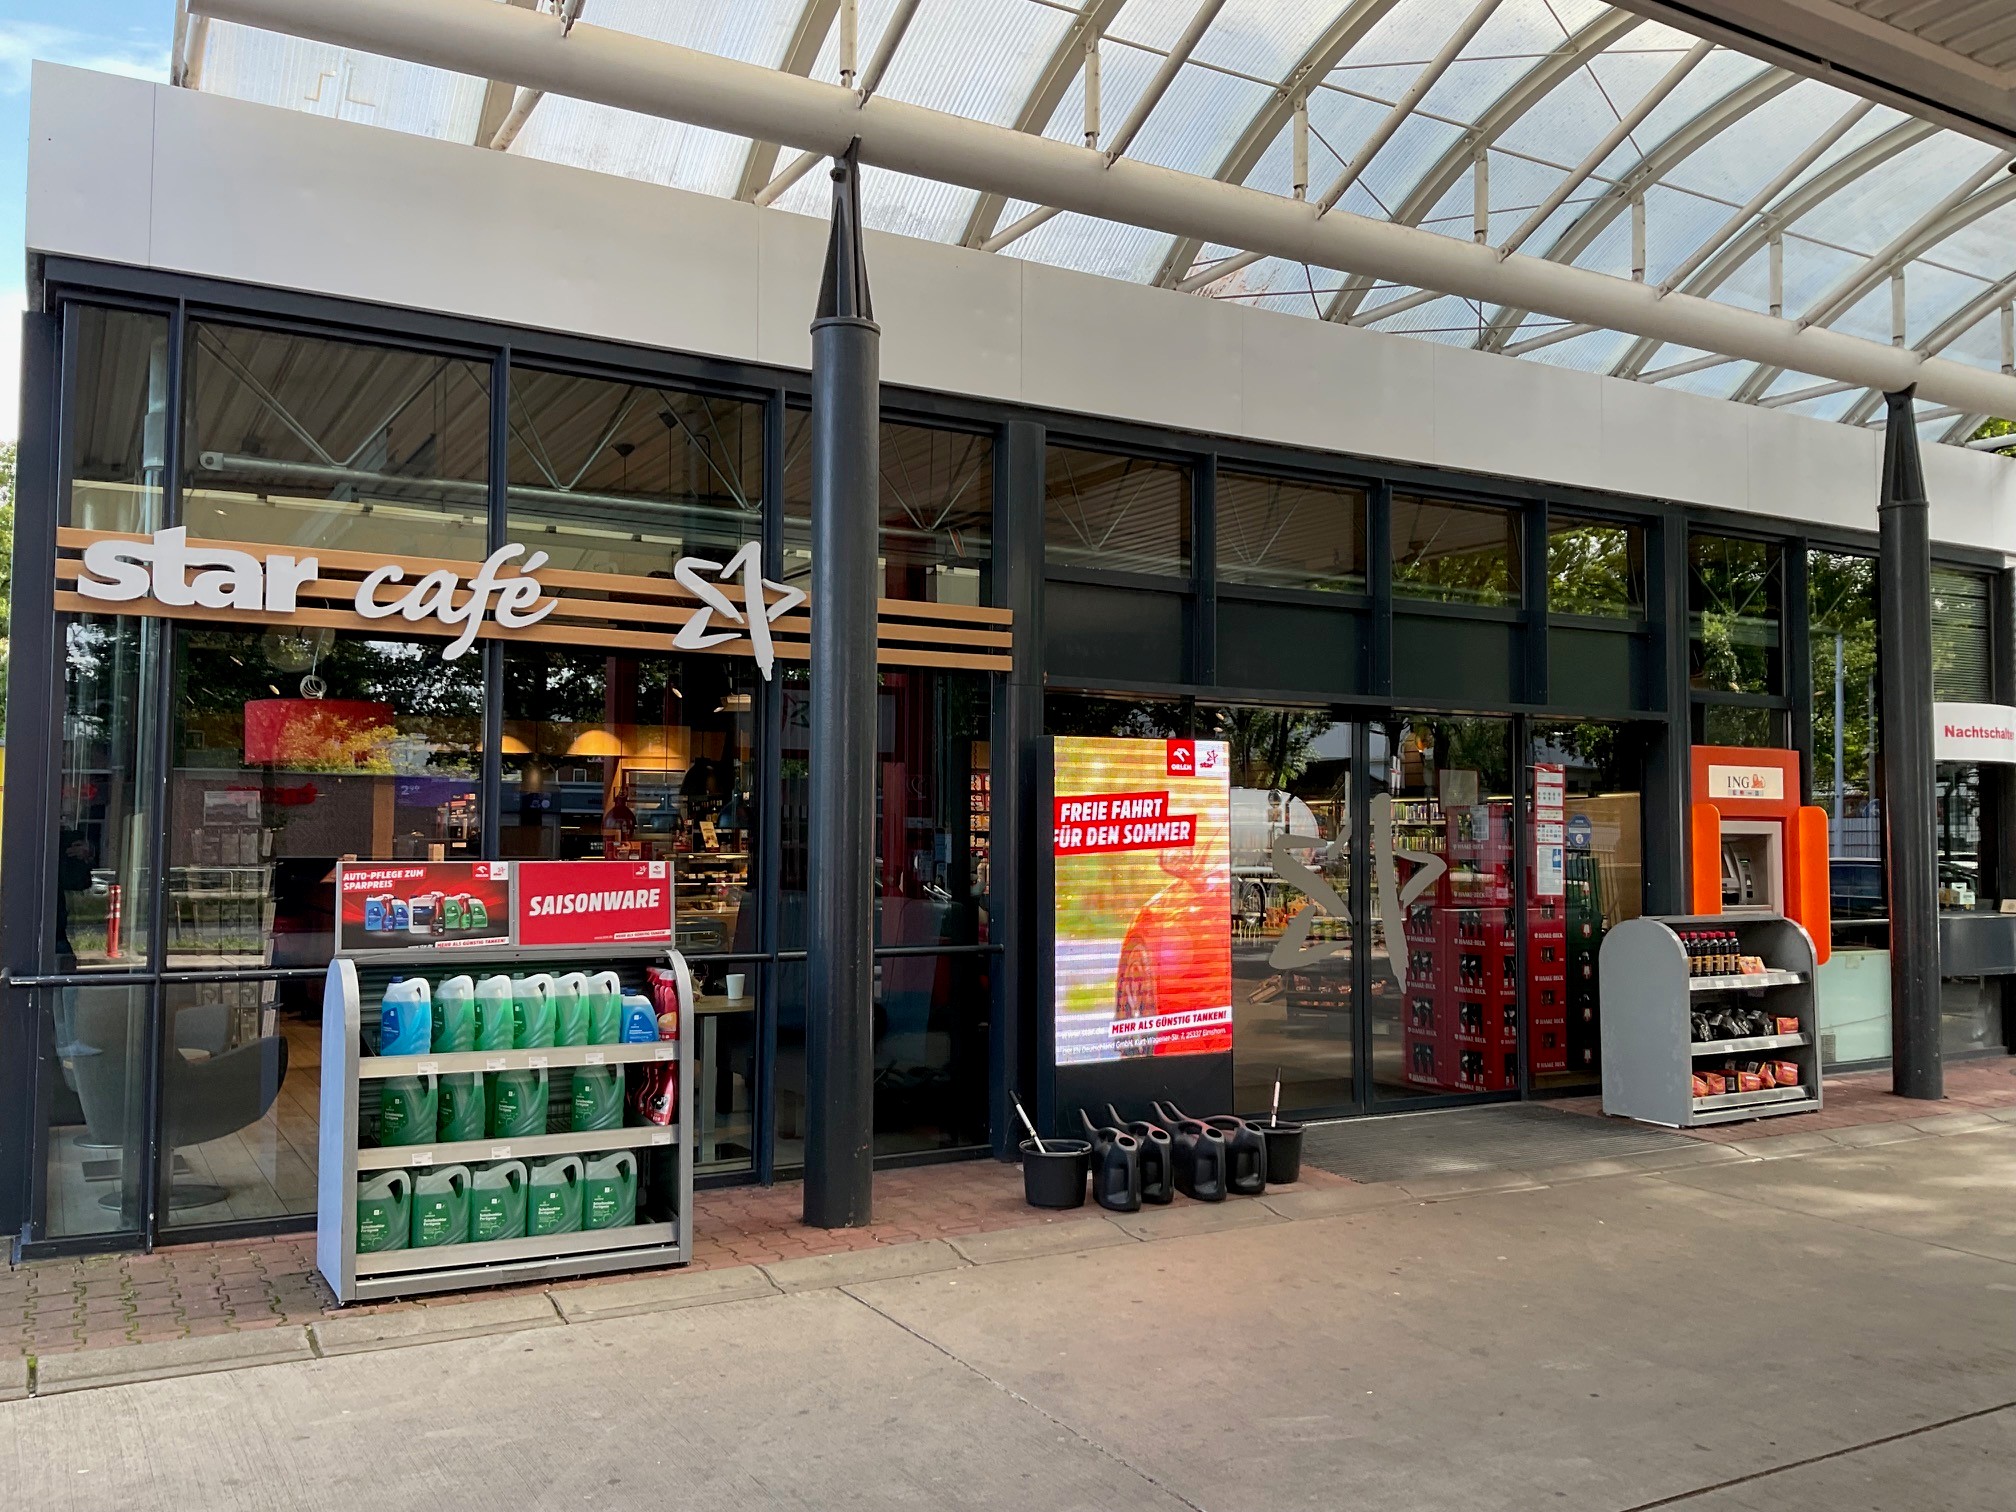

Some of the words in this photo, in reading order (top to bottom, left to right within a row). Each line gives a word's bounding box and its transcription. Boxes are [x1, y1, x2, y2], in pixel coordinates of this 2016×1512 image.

[77, 526, 318, 613] star
[355, 543, 558, 660] café
[1728, 776, 1750, 788] ING
[1060, 801, 1108, 822] FREIE
[1111, 798, 1163, 820] FAHRT
[1086, 825, 1120, 847] DEN
[1122, 821, 1191, 845] SOMMER
[343, 870, 402, 881] AUTO-PFLEGE
[404, 869, 424, 878] ZUM
[343, 880, 393, 890] SPARPREIS
[529, 888, 660, 916] SAISONWARE
[1112, 1024, 1136, 1034] MEHR
[1138, 1020, 1154, 1030] ALS
[1156, 1014, 1190, 1027] GÜNSTIG
[1192, 1010, 1227, 1023] TANKEN!
